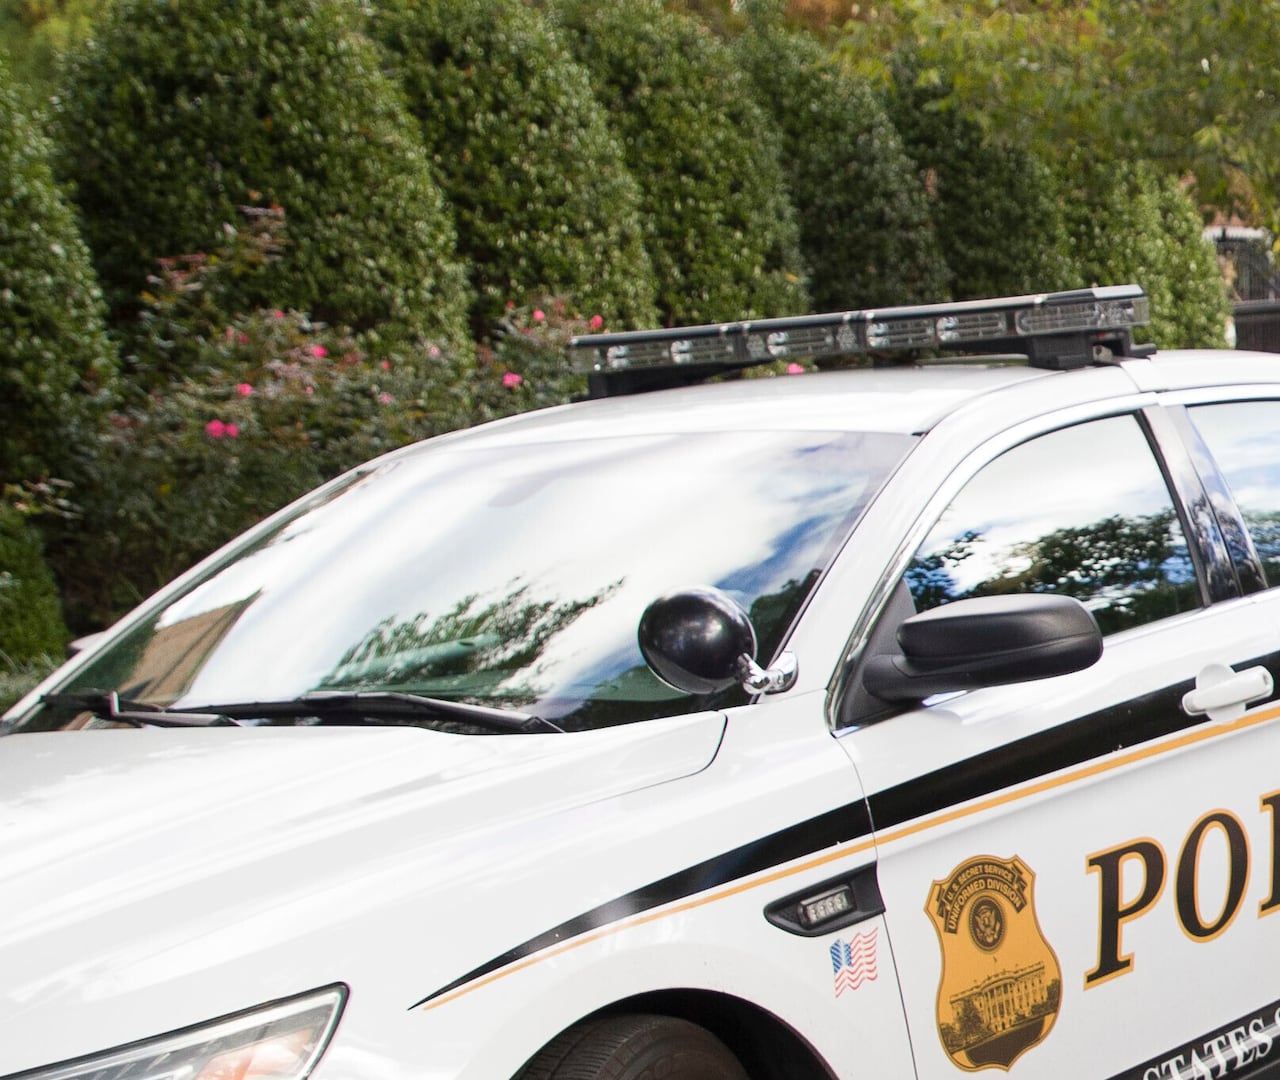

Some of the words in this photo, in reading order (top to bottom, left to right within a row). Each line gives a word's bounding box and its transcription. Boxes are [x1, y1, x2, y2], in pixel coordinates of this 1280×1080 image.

[957, 864, 983, 883] SECRET
[984, 863, 1013, 882] SERVICE
[948, 878, 985, 930] UNIFORMED
[986, 878, 1021, 908] DIVISION
